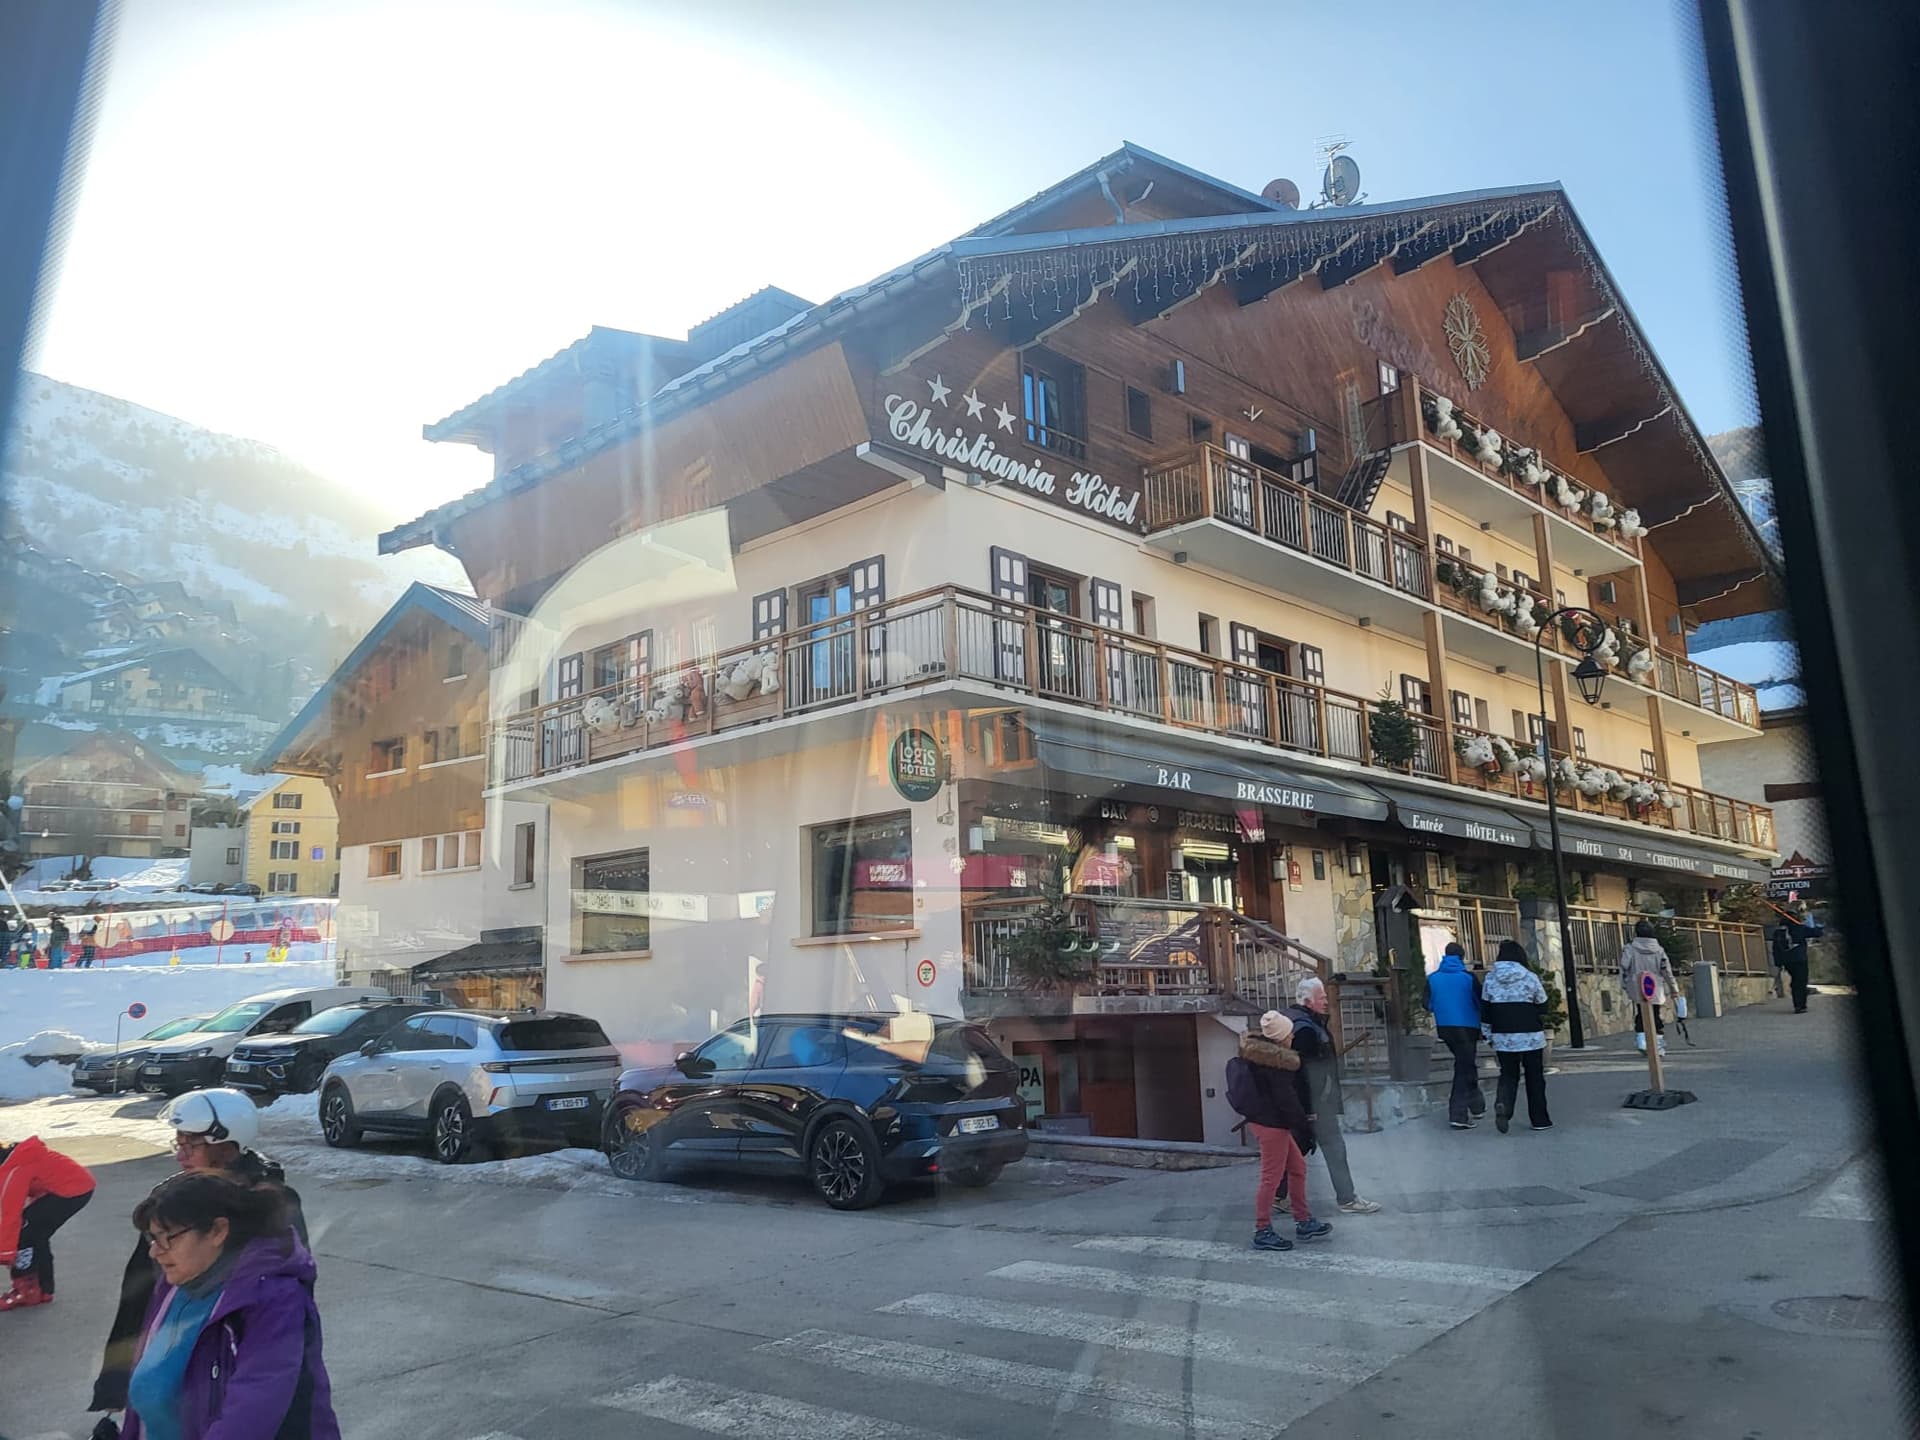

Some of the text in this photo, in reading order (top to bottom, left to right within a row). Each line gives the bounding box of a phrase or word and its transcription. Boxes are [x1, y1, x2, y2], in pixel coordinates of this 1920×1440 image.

[884, 394, 1141, 525] Christiania Hôtel
[1157, 768, 1315, 809] BAR BRASSERIE
[1101, 802, 1242, 834] BAR BRASSERIE
[1412, 814, 1498, 842] Entrée HÔTEL
[1576, 839, 1603, 857] HÔTEL
[1618, 847, 1633, 861] SPA
[1017, 1067, 1042, 1088] PA
